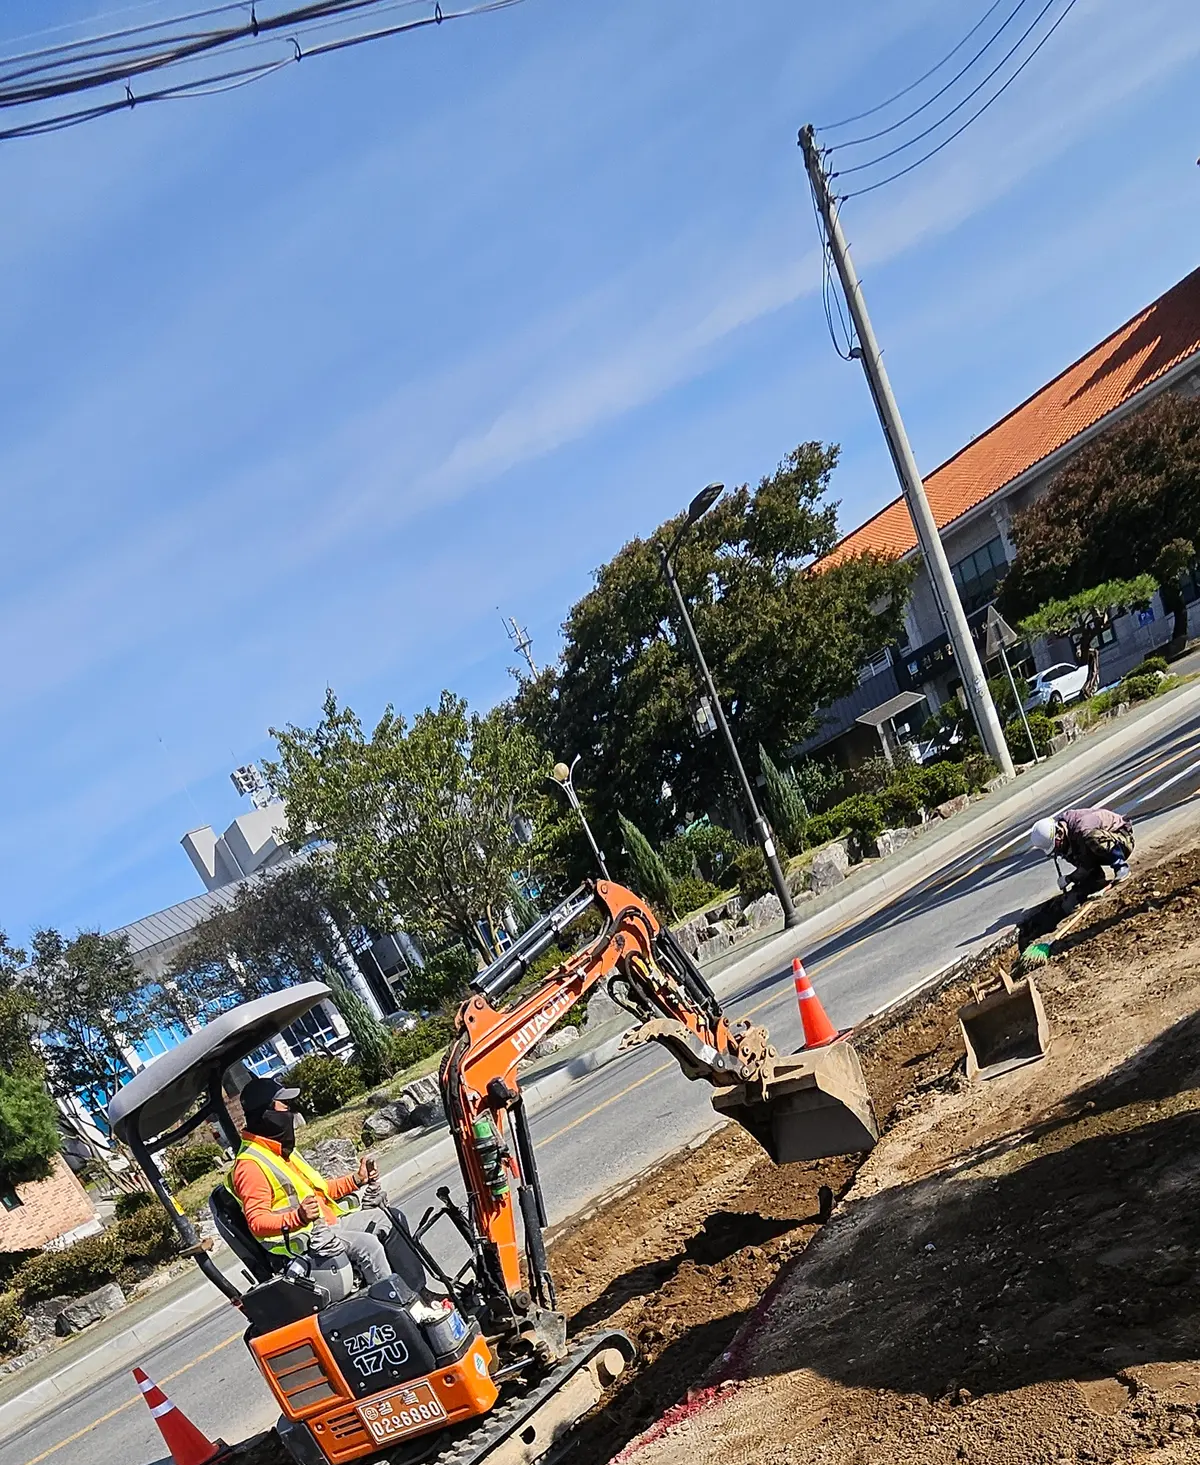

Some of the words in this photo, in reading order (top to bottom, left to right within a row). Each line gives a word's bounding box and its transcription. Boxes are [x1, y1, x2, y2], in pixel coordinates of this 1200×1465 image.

[510, 988, 570, 1052] HITACHI
[343, 1324, 397, 1356] ZAXIS
[353, 1340, 409, 1377] 17U
[372, 1400, 441, 1436] 02오6880
